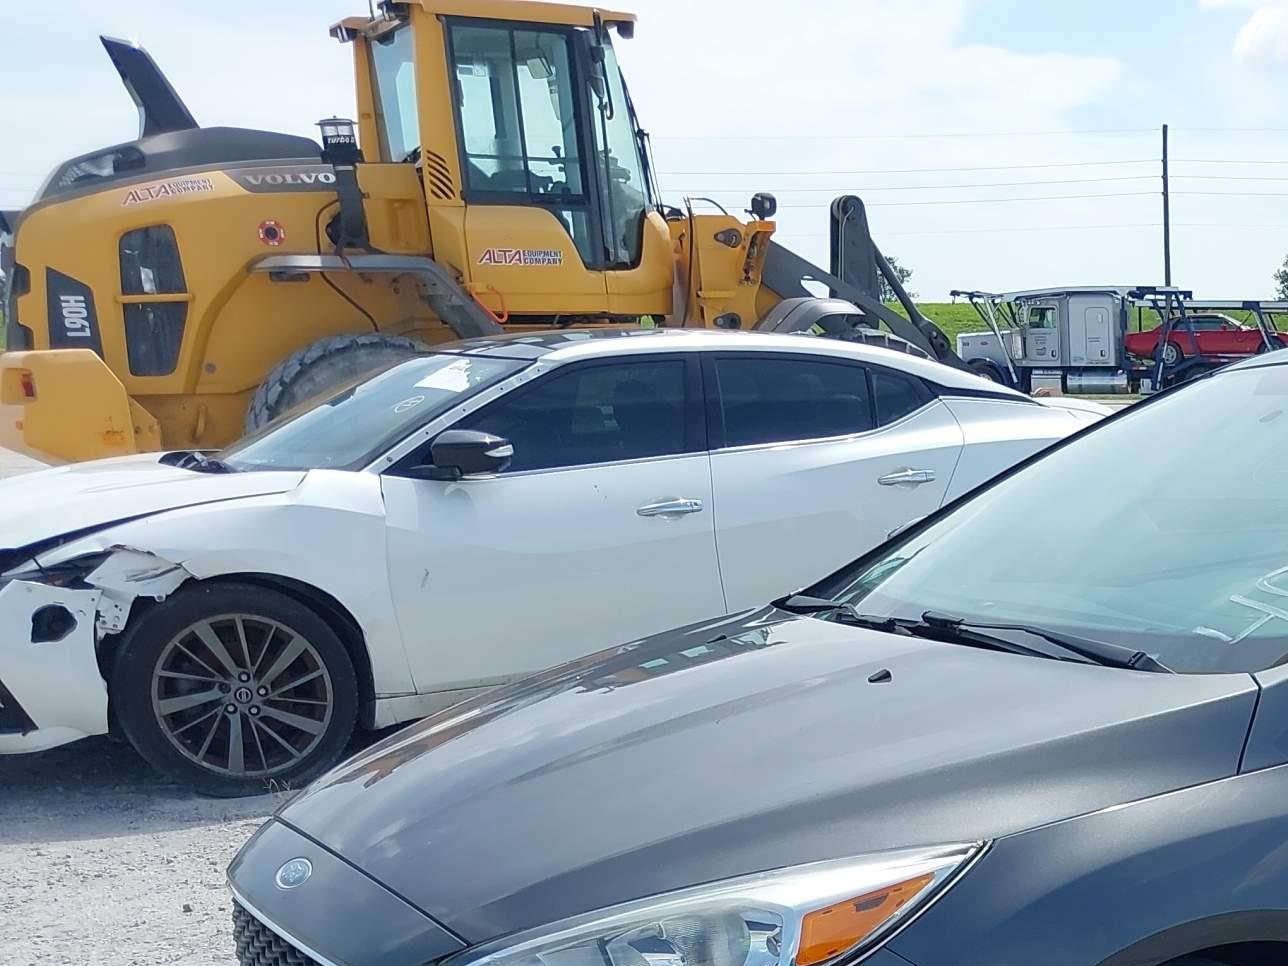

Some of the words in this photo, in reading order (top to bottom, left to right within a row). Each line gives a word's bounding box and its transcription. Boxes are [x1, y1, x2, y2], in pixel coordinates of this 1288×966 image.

[244, 172, 337, 185] VOLVO
[122, 183, 171, 206] ALTA
[479, 248, 523, 265] ALTA
[523, 257, 563, 265] COMPANY
[60, 296, 91, 336] L90H
